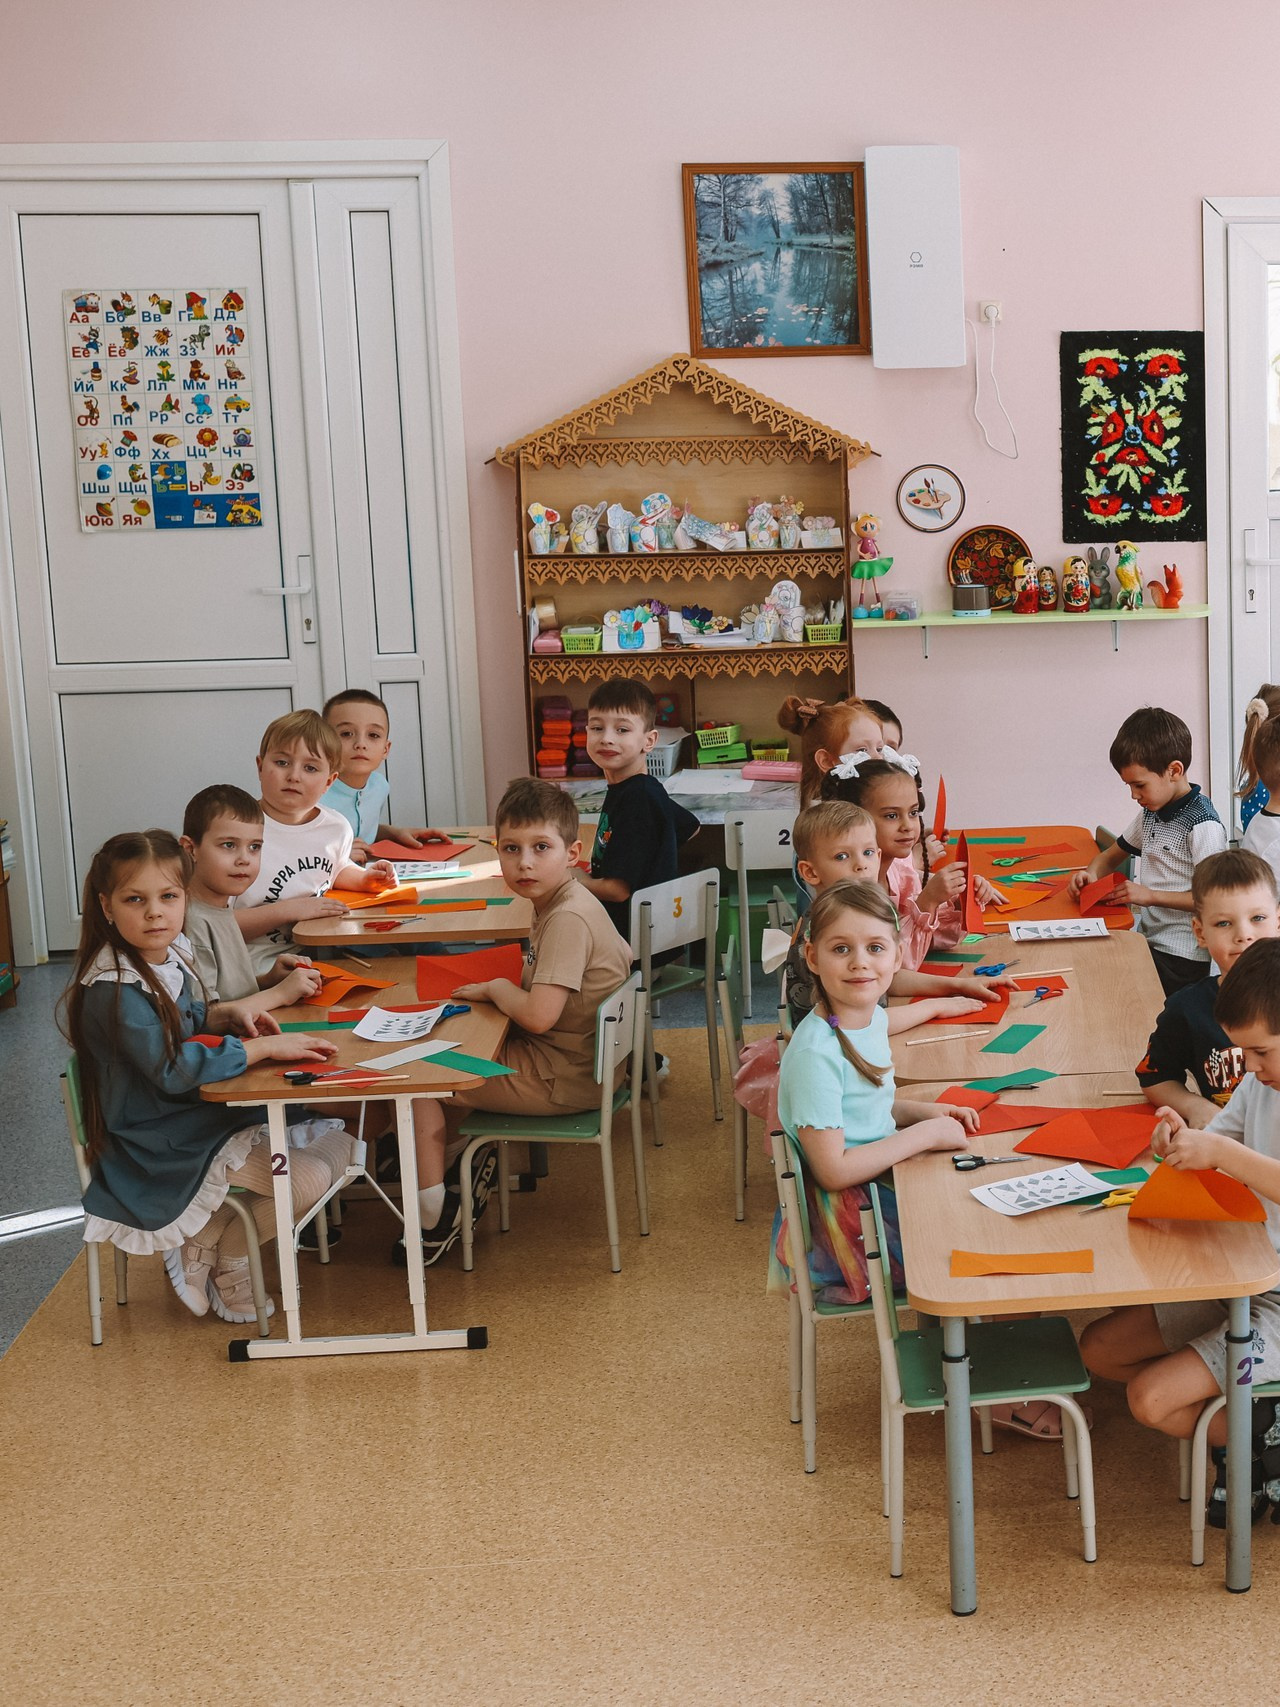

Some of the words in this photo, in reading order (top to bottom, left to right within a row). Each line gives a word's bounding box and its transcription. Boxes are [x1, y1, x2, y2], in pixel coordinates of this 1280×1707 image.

[70, 312, 89, 323] Аа
[105, 311, 125, 323] Бб
[142, 311, 162, 322] Вв
[214, 308, 236, 321] Дд
[72, 347, 90, 358] Ее
[108, 343, 126, 357] Ёё
[144, 346, 170, 356] Жж
[180, 345, 196, 356] Зз
[215, 344, 235, 355] Ии
[74, 377, 94, 392] Йй
[110, 380, 127, 391] Кк
[147, 380, 167, 391] Лл
[183, 379, 206, 390] Мм
[218, 379, 237, 389] Нн
[77, 415, 98, 426] Оо
[113, 414, 132, 425] Пп
[149, 411, 169, 424] Рр
[185, 413, 204, 424] Сс
[222, 412, 239, 423] Тт
[79, 447, 97, 461] Уу
[114, 446, 140, 459] Фф
[152, 449, 170, 459] Хх
[187, 446, 207, 458] Цц
[222, 447, 241, 457] Чч
[82, 482, 109, 494] Шш
[119, 482, 147, 495] Щщ
[190, 481, 203, 492] Ы
[226, 480, 244, 491] Ээ
[85, 515, 113, 526] Юю
[122, 515, 142, 526] Яя
[779, 829, 791, 845] 2
[263, 865, 296, 903] KAPPA
[298, 857, 333, 876] ALPHA
[673, 897, 683, 918] 3
[618, 1001, 624, 1024] 2
[1204, 1047, 1244, 1088] SPEE
[271, 1153, 288, 1175] 2
[1237, 1357, 1252, 1385] 2
